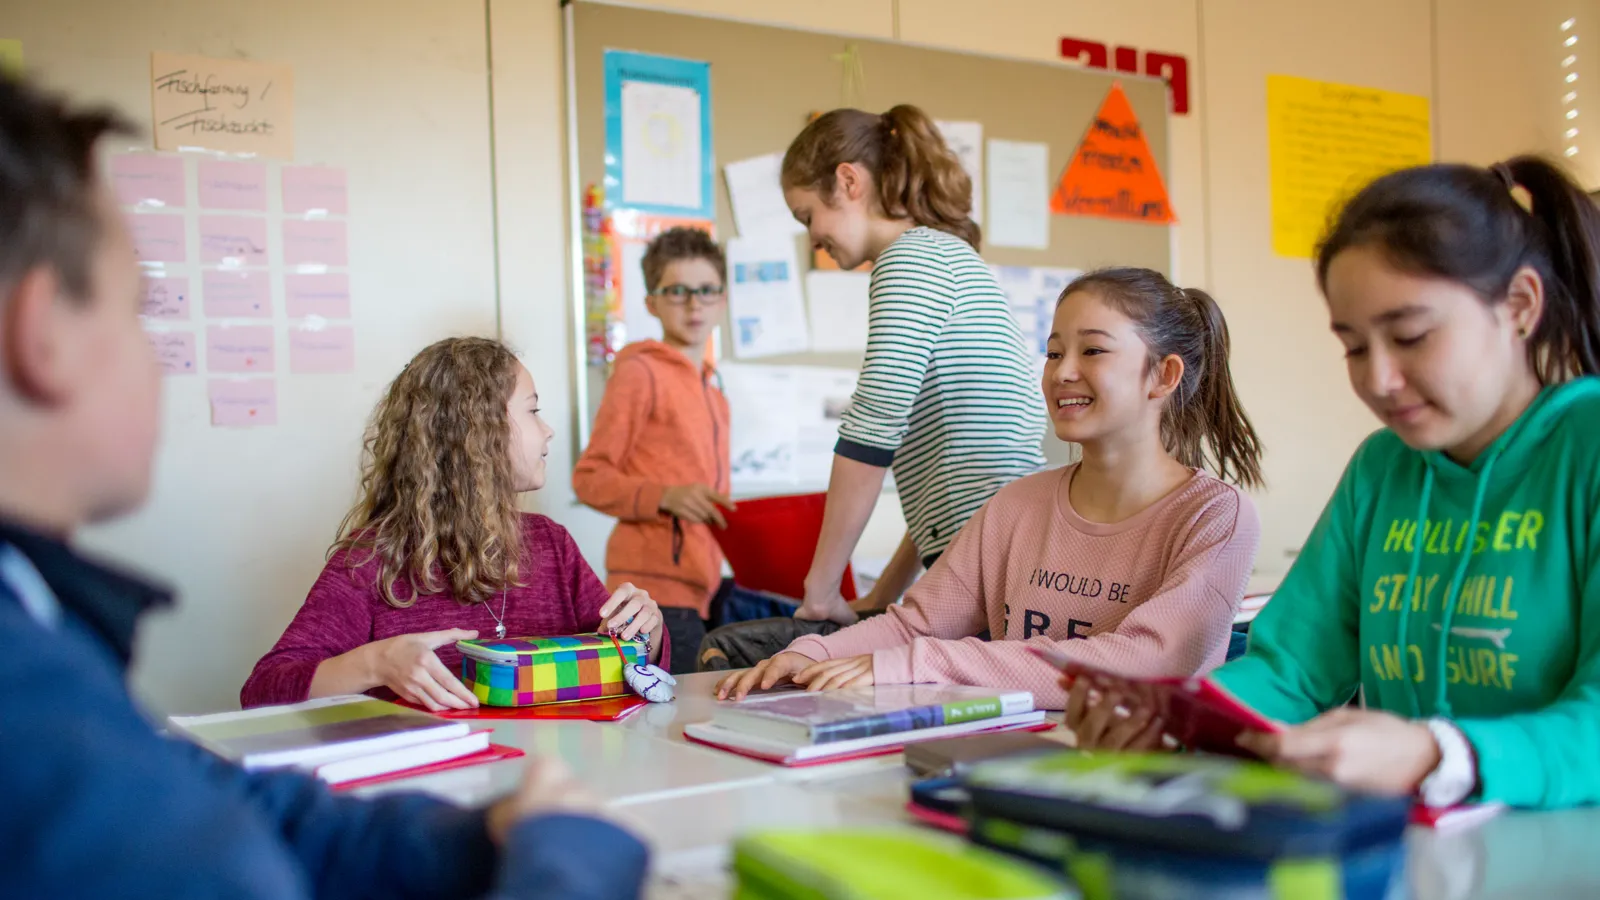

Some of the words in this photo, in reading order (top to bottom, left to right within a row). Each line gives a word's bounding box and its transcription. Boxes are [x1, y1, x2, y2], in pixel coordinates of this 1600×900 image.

[1382, 509, 1545, 555] HOLLISER
[1029, 568, 1037, 585] I
[1037, 568, 1102, 598] WOULD
[1107, 582, 1130, 604] BE
